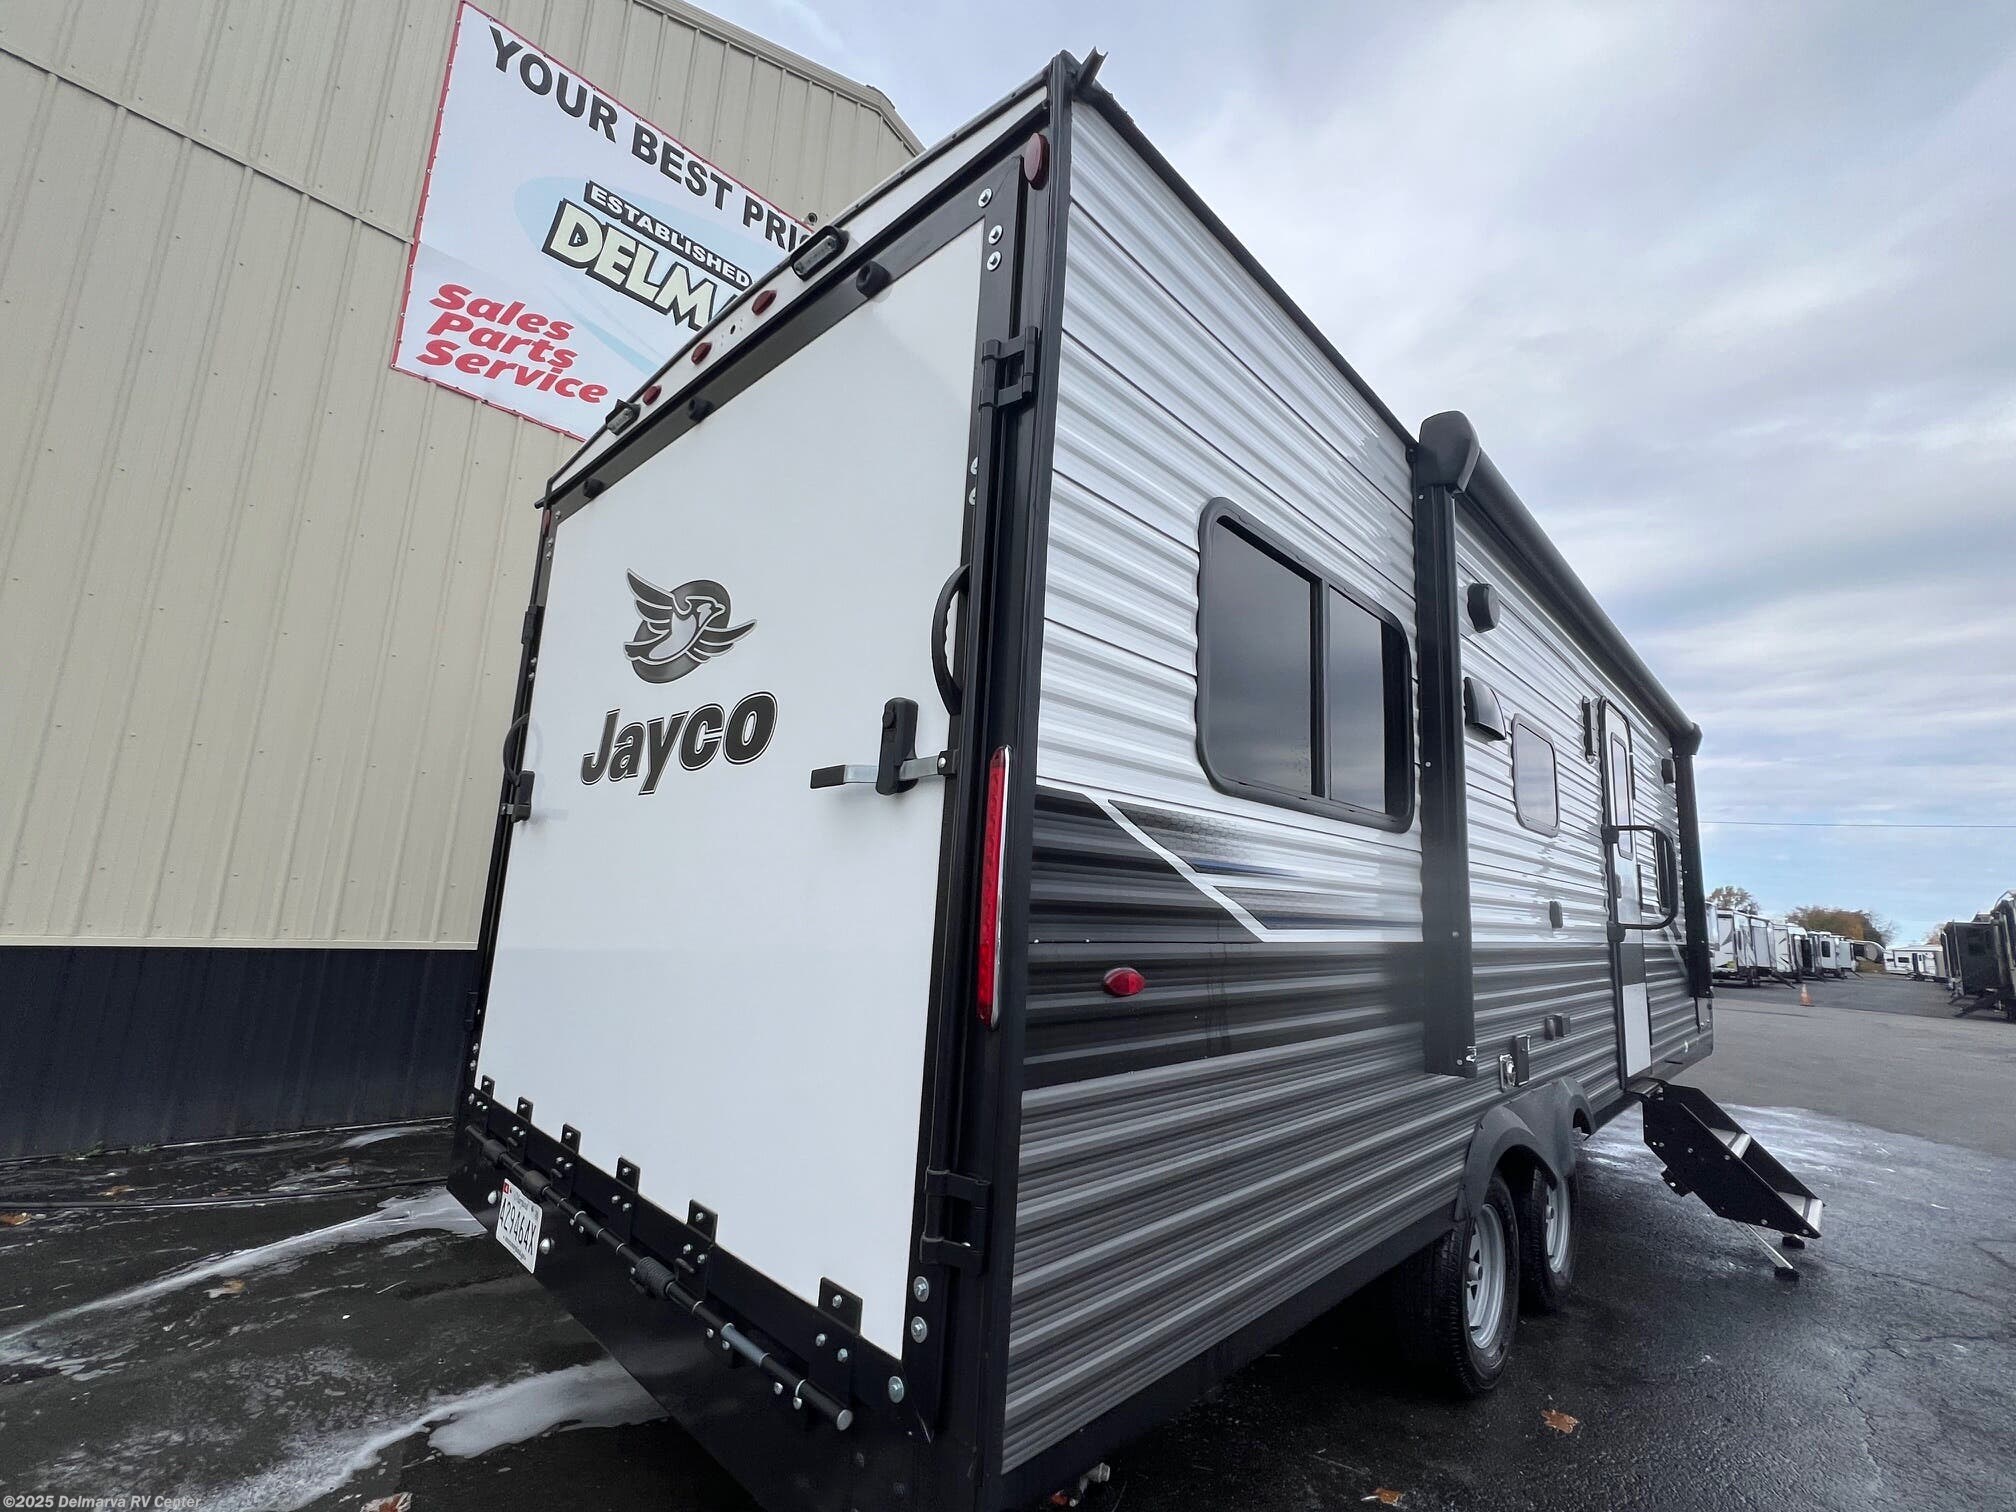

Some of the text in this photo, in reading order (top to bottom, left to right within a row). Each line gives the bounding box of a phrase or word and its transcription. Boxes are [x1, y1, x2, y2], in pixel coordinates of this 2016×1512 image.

[489, 25, 810, 252] YOUR BEST PRI
[541, 198, 736, 331] DELM
[590, 184, 751, 287] ESTABLISHED
[427, 312, 578, 370] Parts
[428, 283, 575, 342] Sales
[416, 339, 608, 404] Service
[580, 691, 778, 795] Jayco
